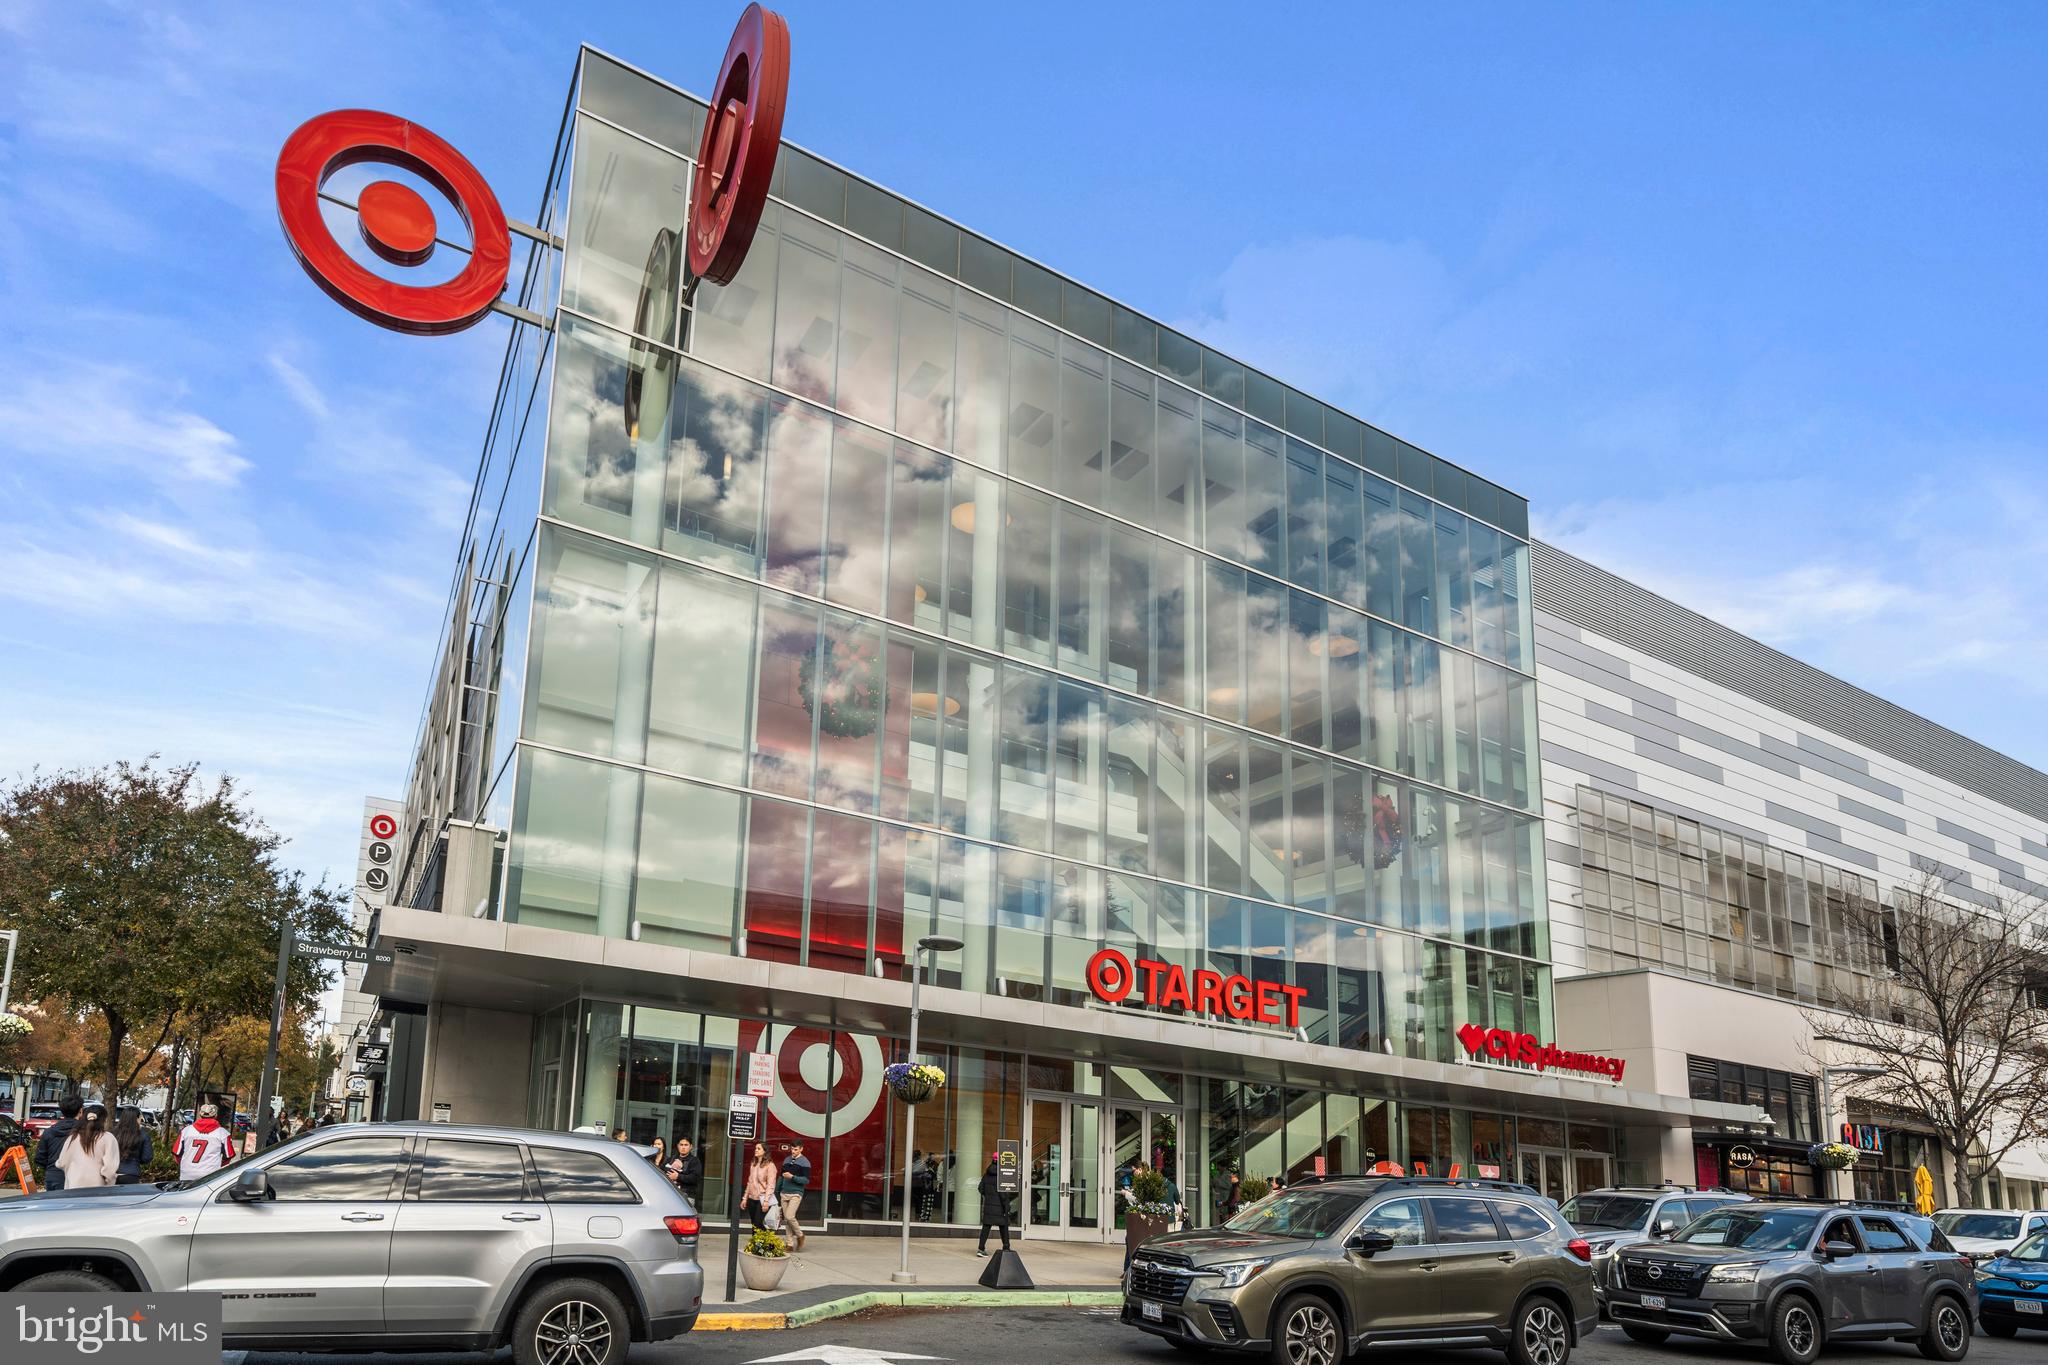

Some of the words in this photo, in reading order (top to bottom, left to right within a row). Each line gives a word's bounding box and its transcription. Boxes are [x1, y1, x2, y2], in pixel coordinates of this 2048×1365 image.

[375, 845, 387, 858] P
[298, 943, 353, 960] Strawberry
[354, 950, 367, 960] Ln
[1135, 959, 1308, 1028] TARGET
[1485, 1028, 1538, 1064] CVS
[1537, 1043, 1626, 1081] pharmacy
[1844, 1122, 1883, 1151] RASA
[192, 1139, 209, 1163] 7
[1731, 1152, 1752, 1161] RASA
